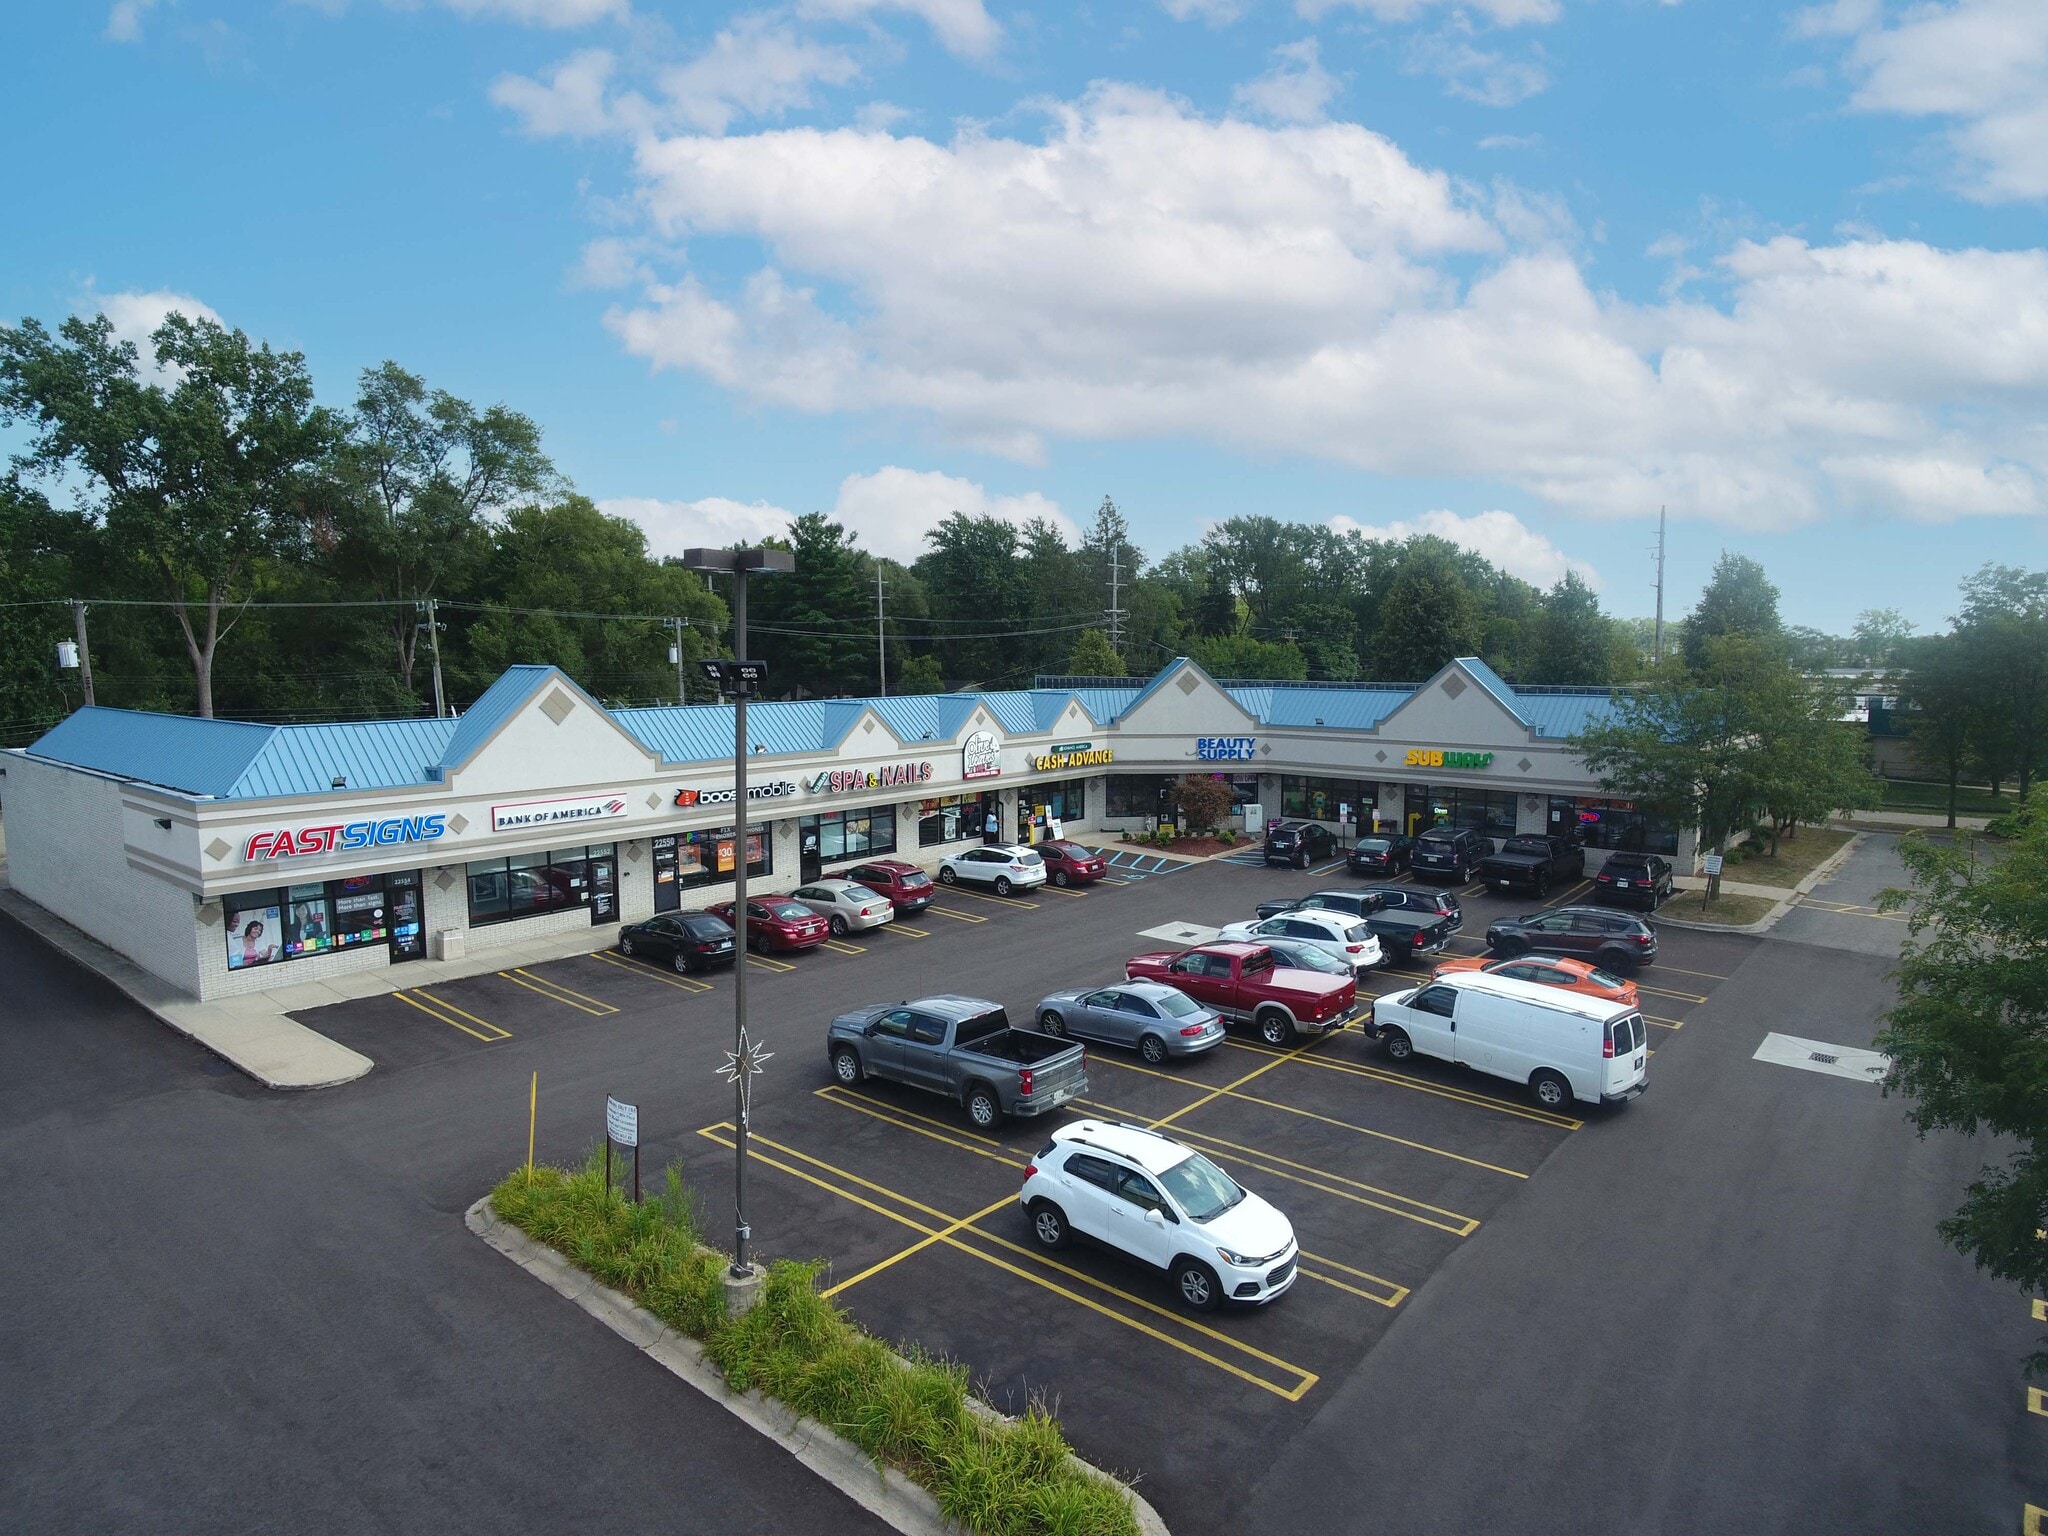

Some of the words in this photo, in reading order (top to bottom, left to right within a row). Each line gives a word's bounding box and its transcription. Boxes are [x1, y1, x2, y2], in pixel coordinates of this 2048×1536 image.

[1197, 738, 1256, 749] BEAUTY
[1036, 754, 1064, 771] CASH
[1068, 749, 1113, 767] ADVANCE
[1198, 749, 1255, 760] SUPPLY
[1404, 749, 1494, 769] SUBWAY
[831, 769, 867, 792] SPA
[868, 772, 878, 788] &
[881, 762, 933, 786] NAILS
[700, 790, 736, 804] boos
[747, 782, 797, 799] mobile
[499, 815, 531, 826] BANK
[535, 812, 549, 821] OF
[552, 807, 602, 819] AMERICA
[245, 814, 446, 861] FASTSIGNS
[654, 837, 675, 848] 22550
